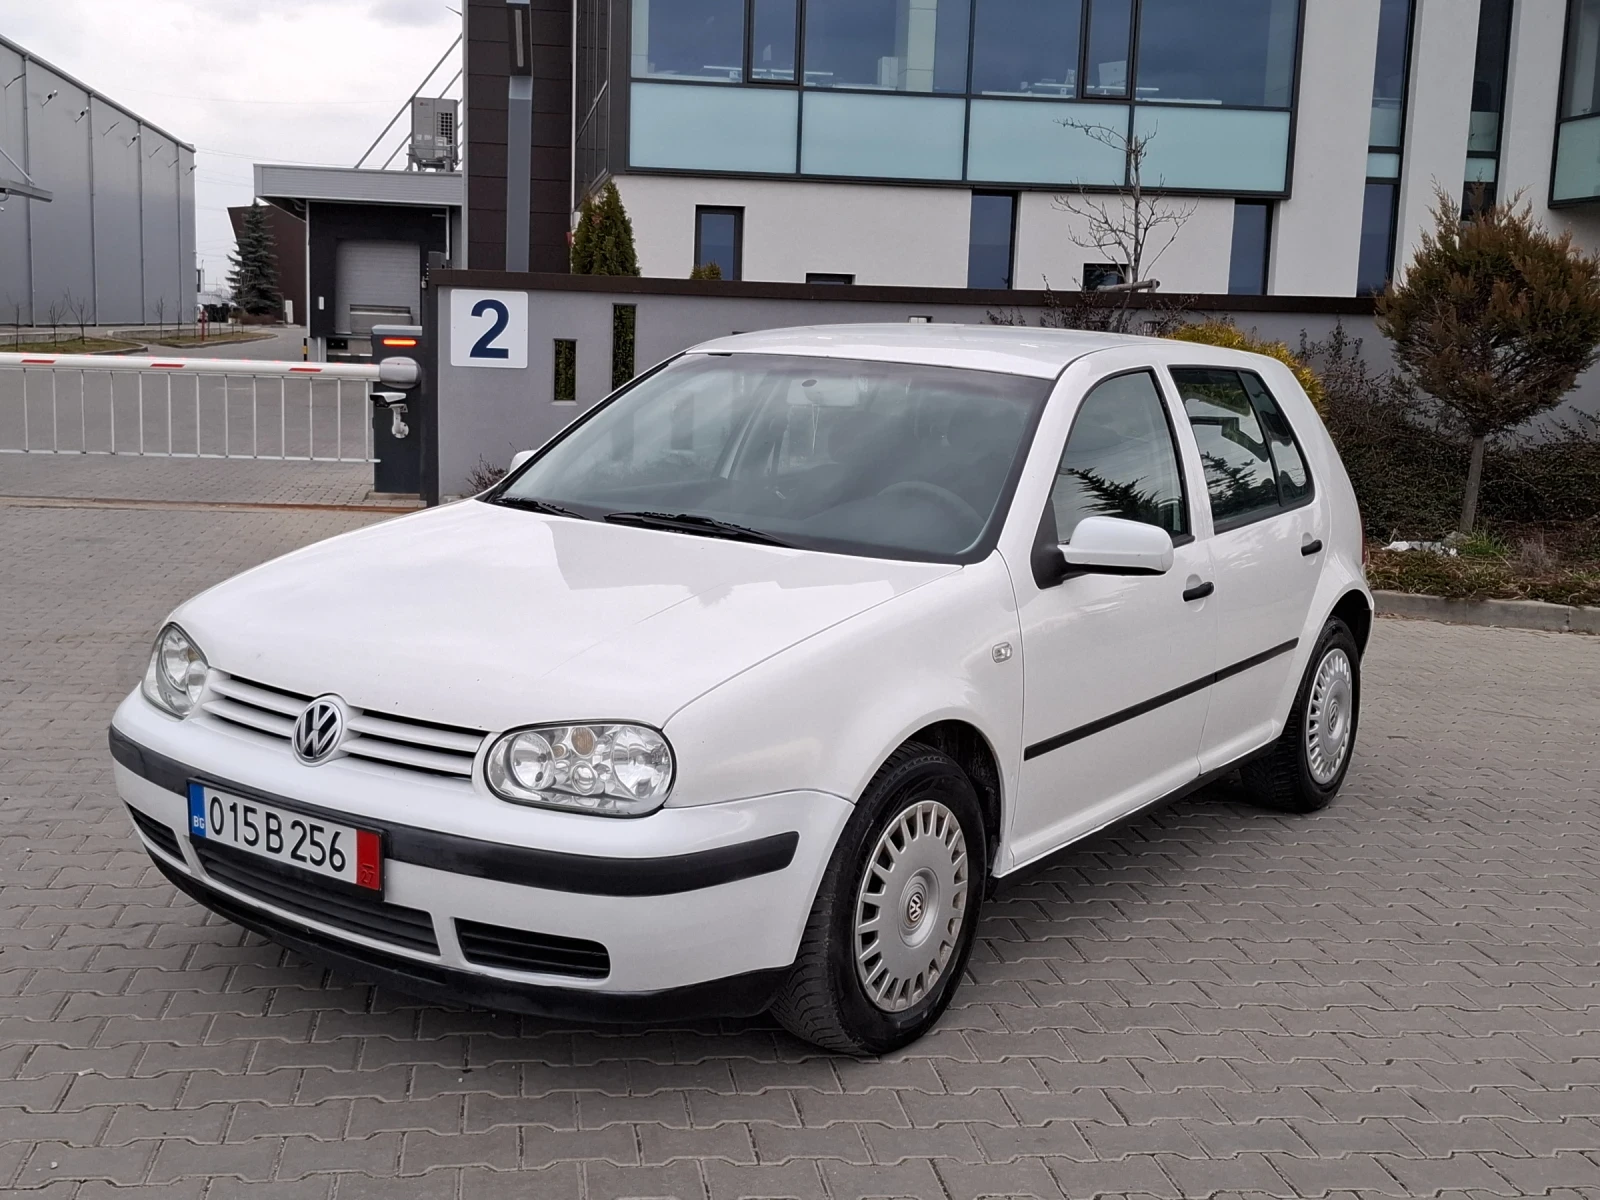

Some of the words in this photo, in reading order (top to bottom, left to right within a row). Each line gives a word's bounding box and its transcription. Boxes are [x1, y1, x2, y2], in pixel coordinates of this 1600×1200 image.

[469, 299, 510, 360] 2
[193, 815, 206, 830] BG
[360, 868, 376, 885] 27
